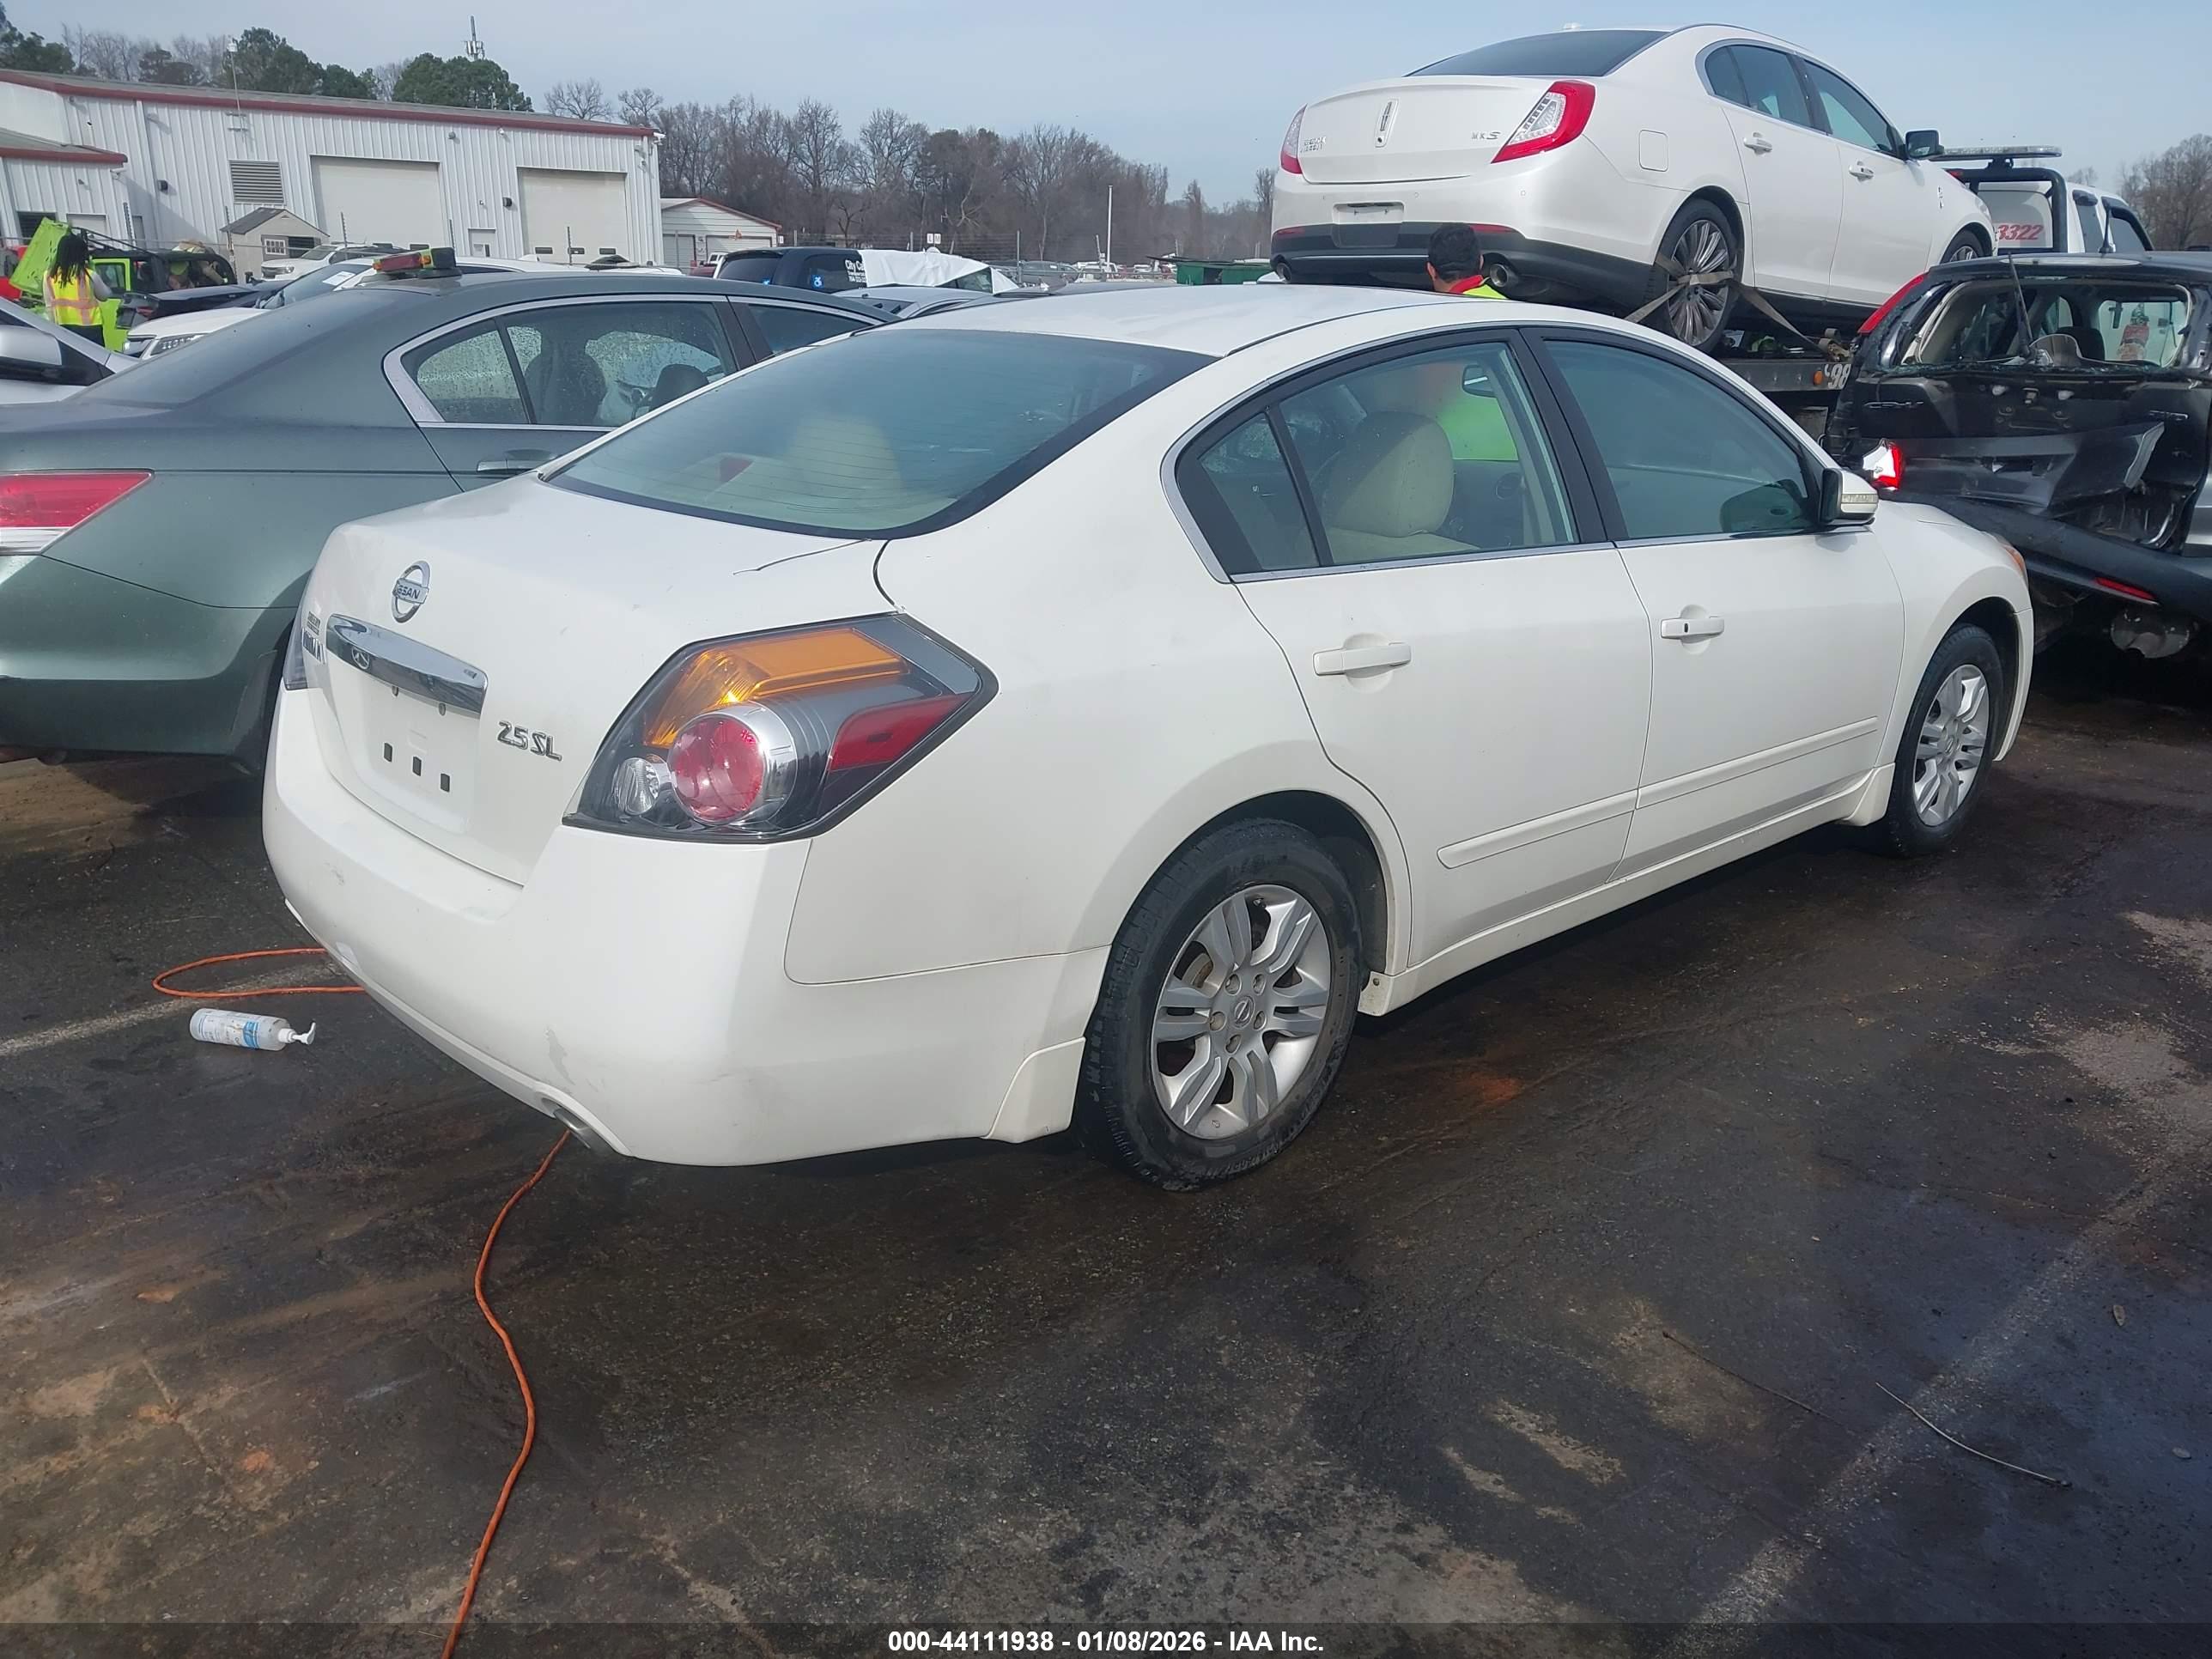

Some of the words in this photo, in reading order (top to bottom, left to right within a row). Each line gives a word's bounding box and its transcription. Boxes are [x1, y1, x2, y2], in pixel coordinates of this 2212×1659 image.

[1471, 131, 1501, 140] MKS
[1997, 224, 2044, 240] 3322
[845, 259, 855, 272] City
